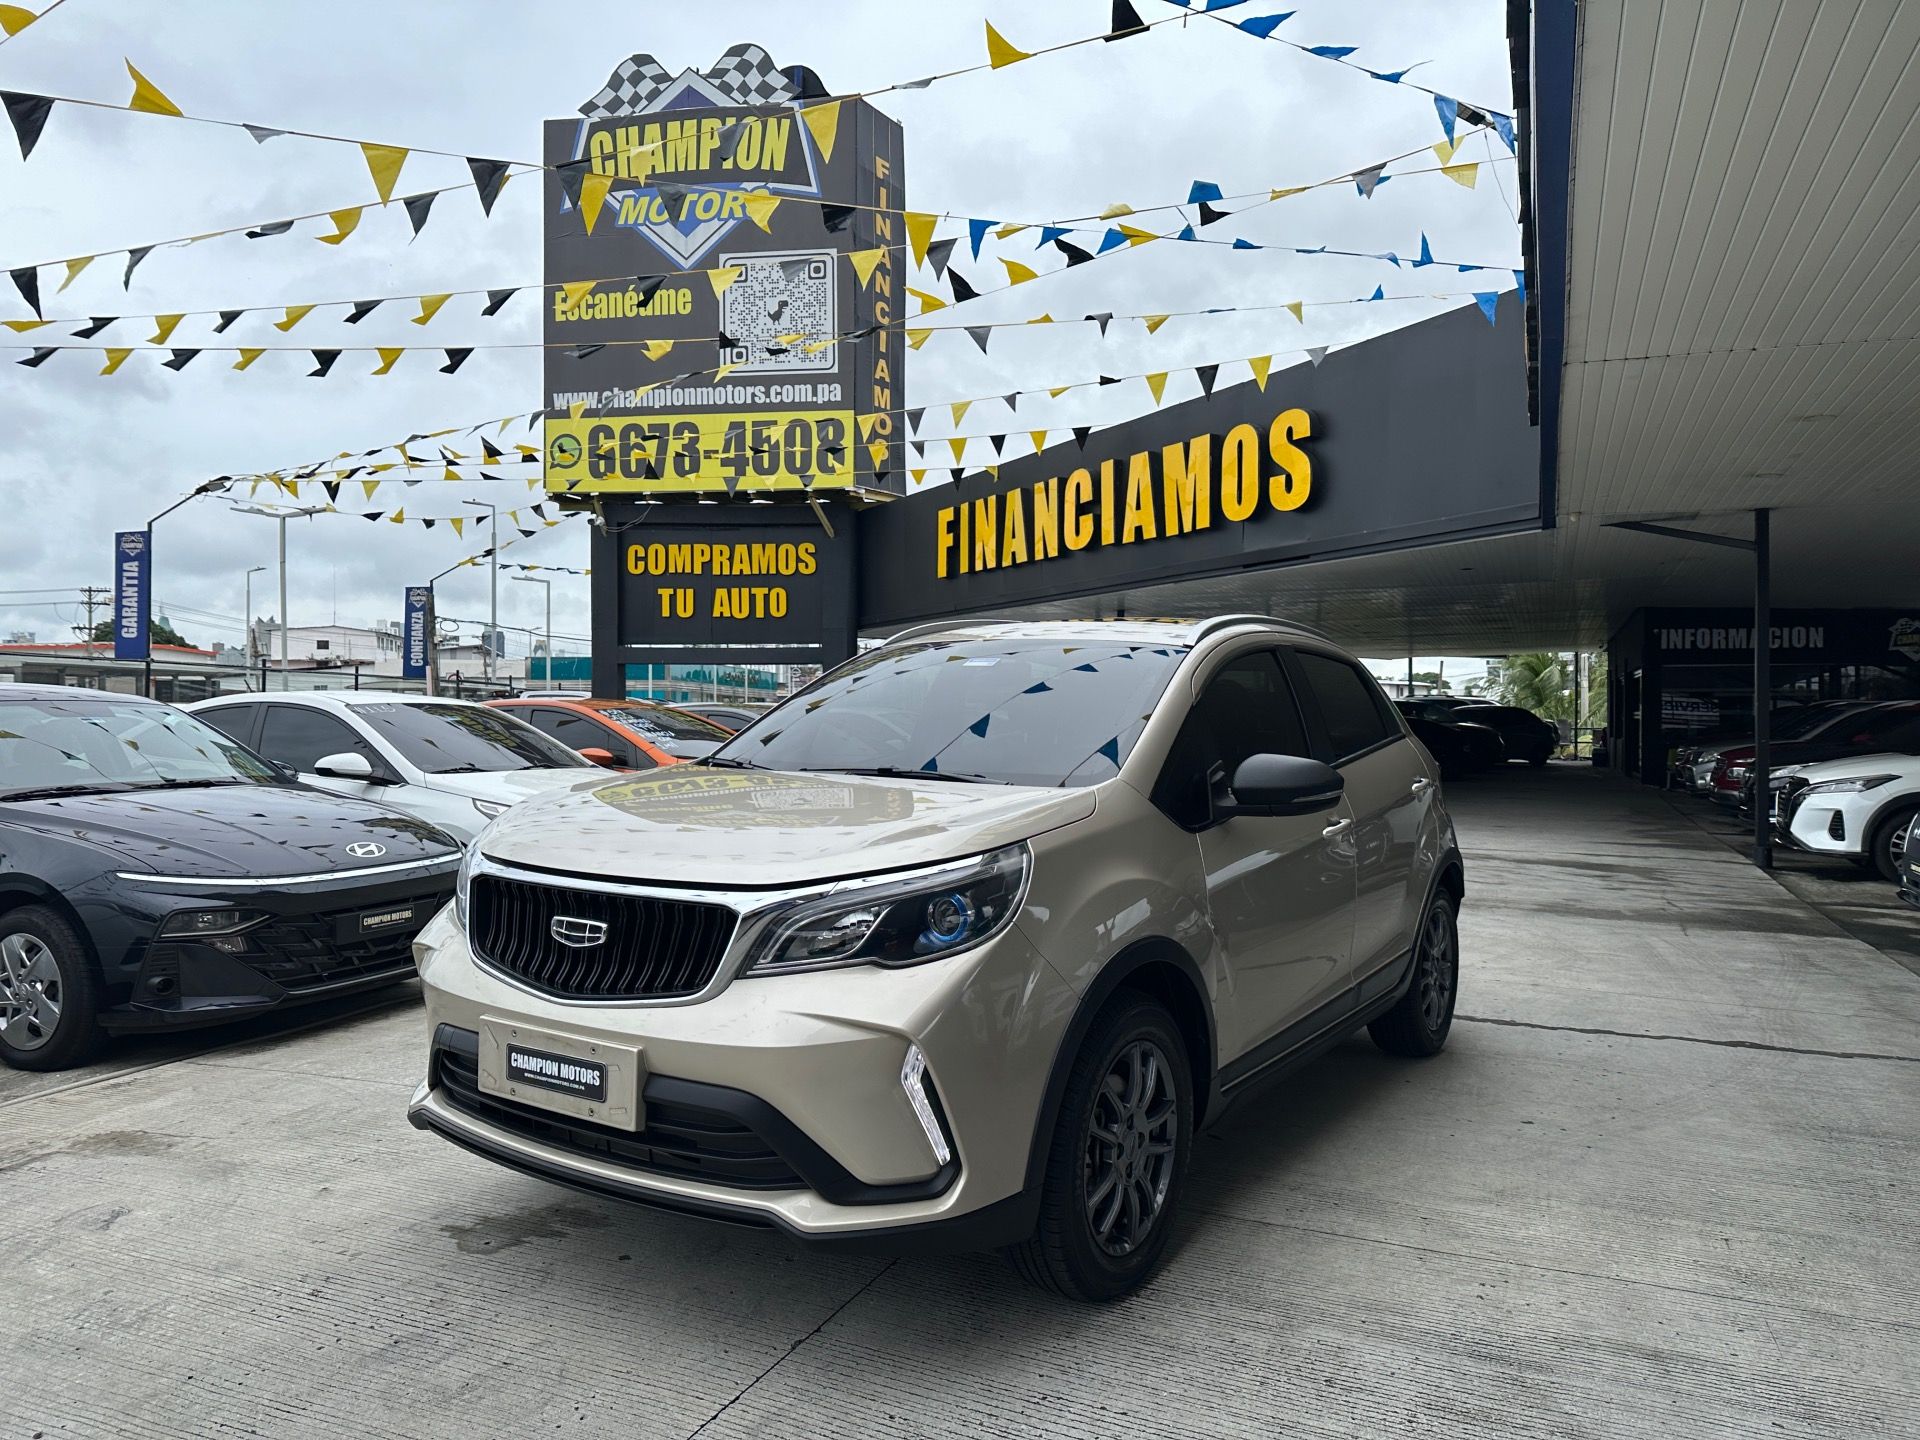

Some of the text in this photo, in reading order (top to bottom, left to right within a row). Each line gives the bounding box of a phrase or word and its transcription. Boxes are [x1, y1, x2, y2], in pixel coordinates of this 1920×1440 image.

[617, 188, 771, 226] MOTOR
[552, 383, 842, 411] www.championmotors.com.pa
[588, 418, 845, 480] 6673-4508
[936, 408, 1312, 579] FINANCIAMOS
[627, 542, 817, 576] COMPRAMOS
[121, 560, 139, 639] GARANTIA
[657, 587, 788, 619] TU AUTO
[410, 611, 424, 667] CONFIANZA
[1660, 626, 1824, 650] INFORMCION
[363, 913, 391, 926] CHAMPION
[391, 909, 412, 921] MOTORS
[511, 1052, 600, 1087] CHAMPION MOTORS
